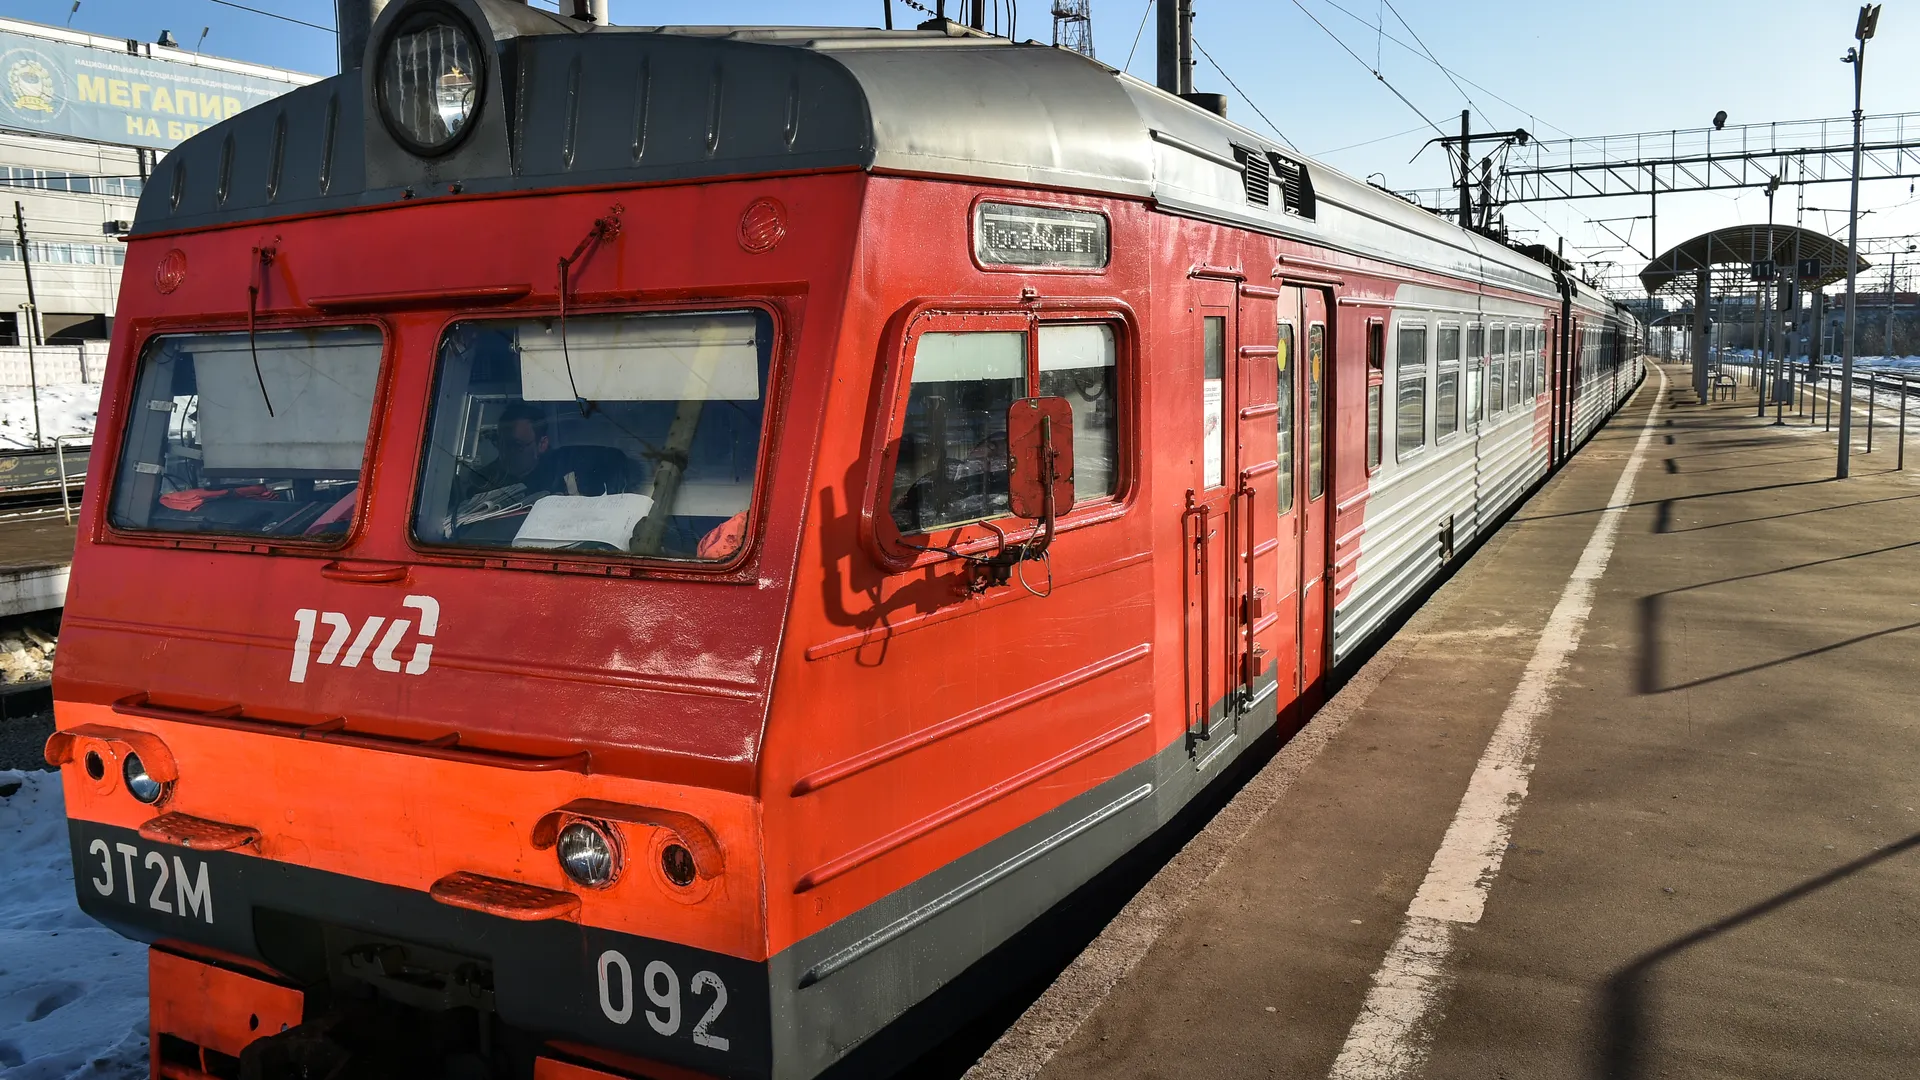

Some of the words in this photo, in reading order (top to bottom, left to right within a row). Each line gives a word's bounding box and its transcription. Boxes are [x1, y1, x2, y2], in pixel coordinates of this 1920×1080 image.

[75, 58, 139, 75] НАЦИОНАЛЬНАЯ
[140, 69, 189, 83] АССОЦИАЦИЯ
[77, 73, 241, 120] МЕГАПИР
[126, 115, 161, 138] НА
[1754, 263, 1770, 277] 11
[1804, 261, 1812, 275] 1
[89, 838, 213, 924] ЭТ2М
[597, 949, 730, 1051] 092
